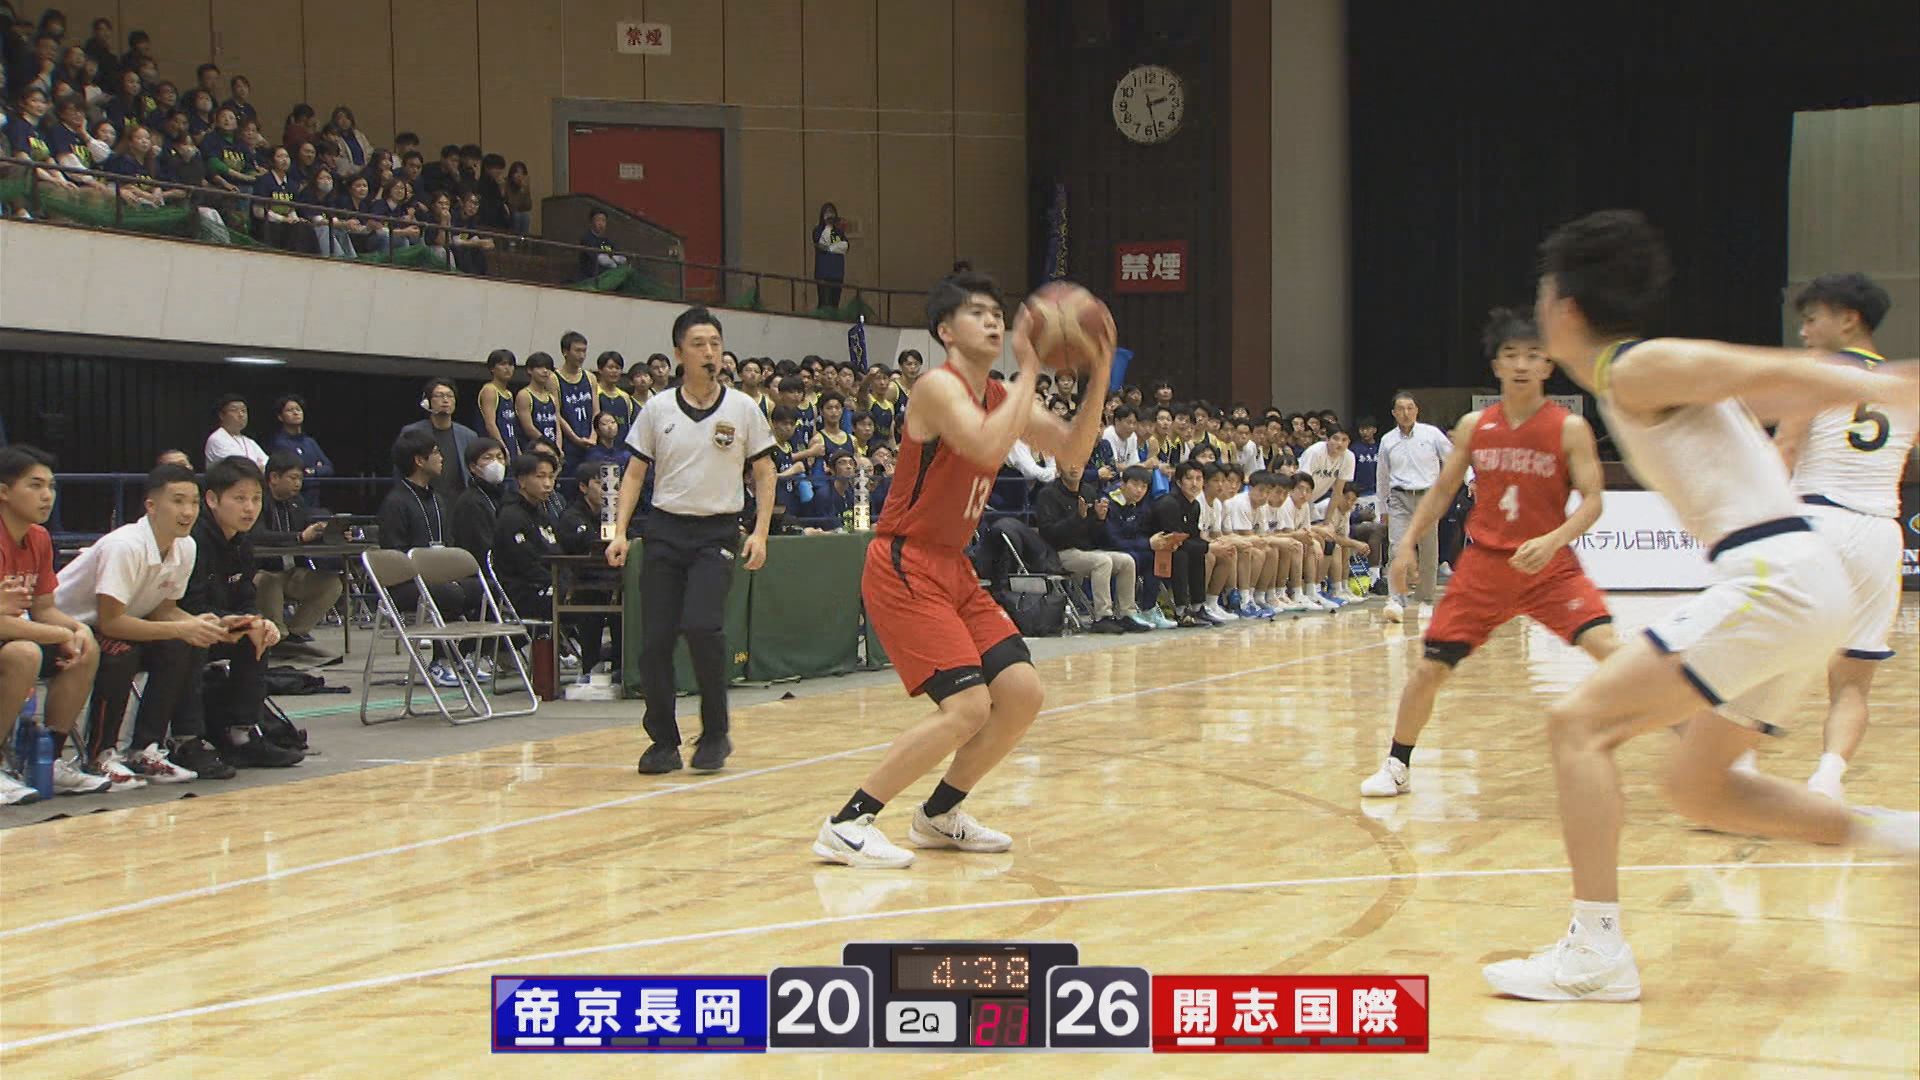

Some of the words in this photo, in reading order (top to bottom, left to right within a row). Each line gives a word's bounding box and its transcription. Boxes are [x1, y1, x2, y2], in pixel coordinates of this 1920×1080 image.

[625, 27, 662, 46] 禁煙
[1121, 253, 1181, 280] 禁煙
[1847, 403, 1890, 452] 5
[963, 476, 990, 519] 13
[1498, 485, 1519, 522] 4
